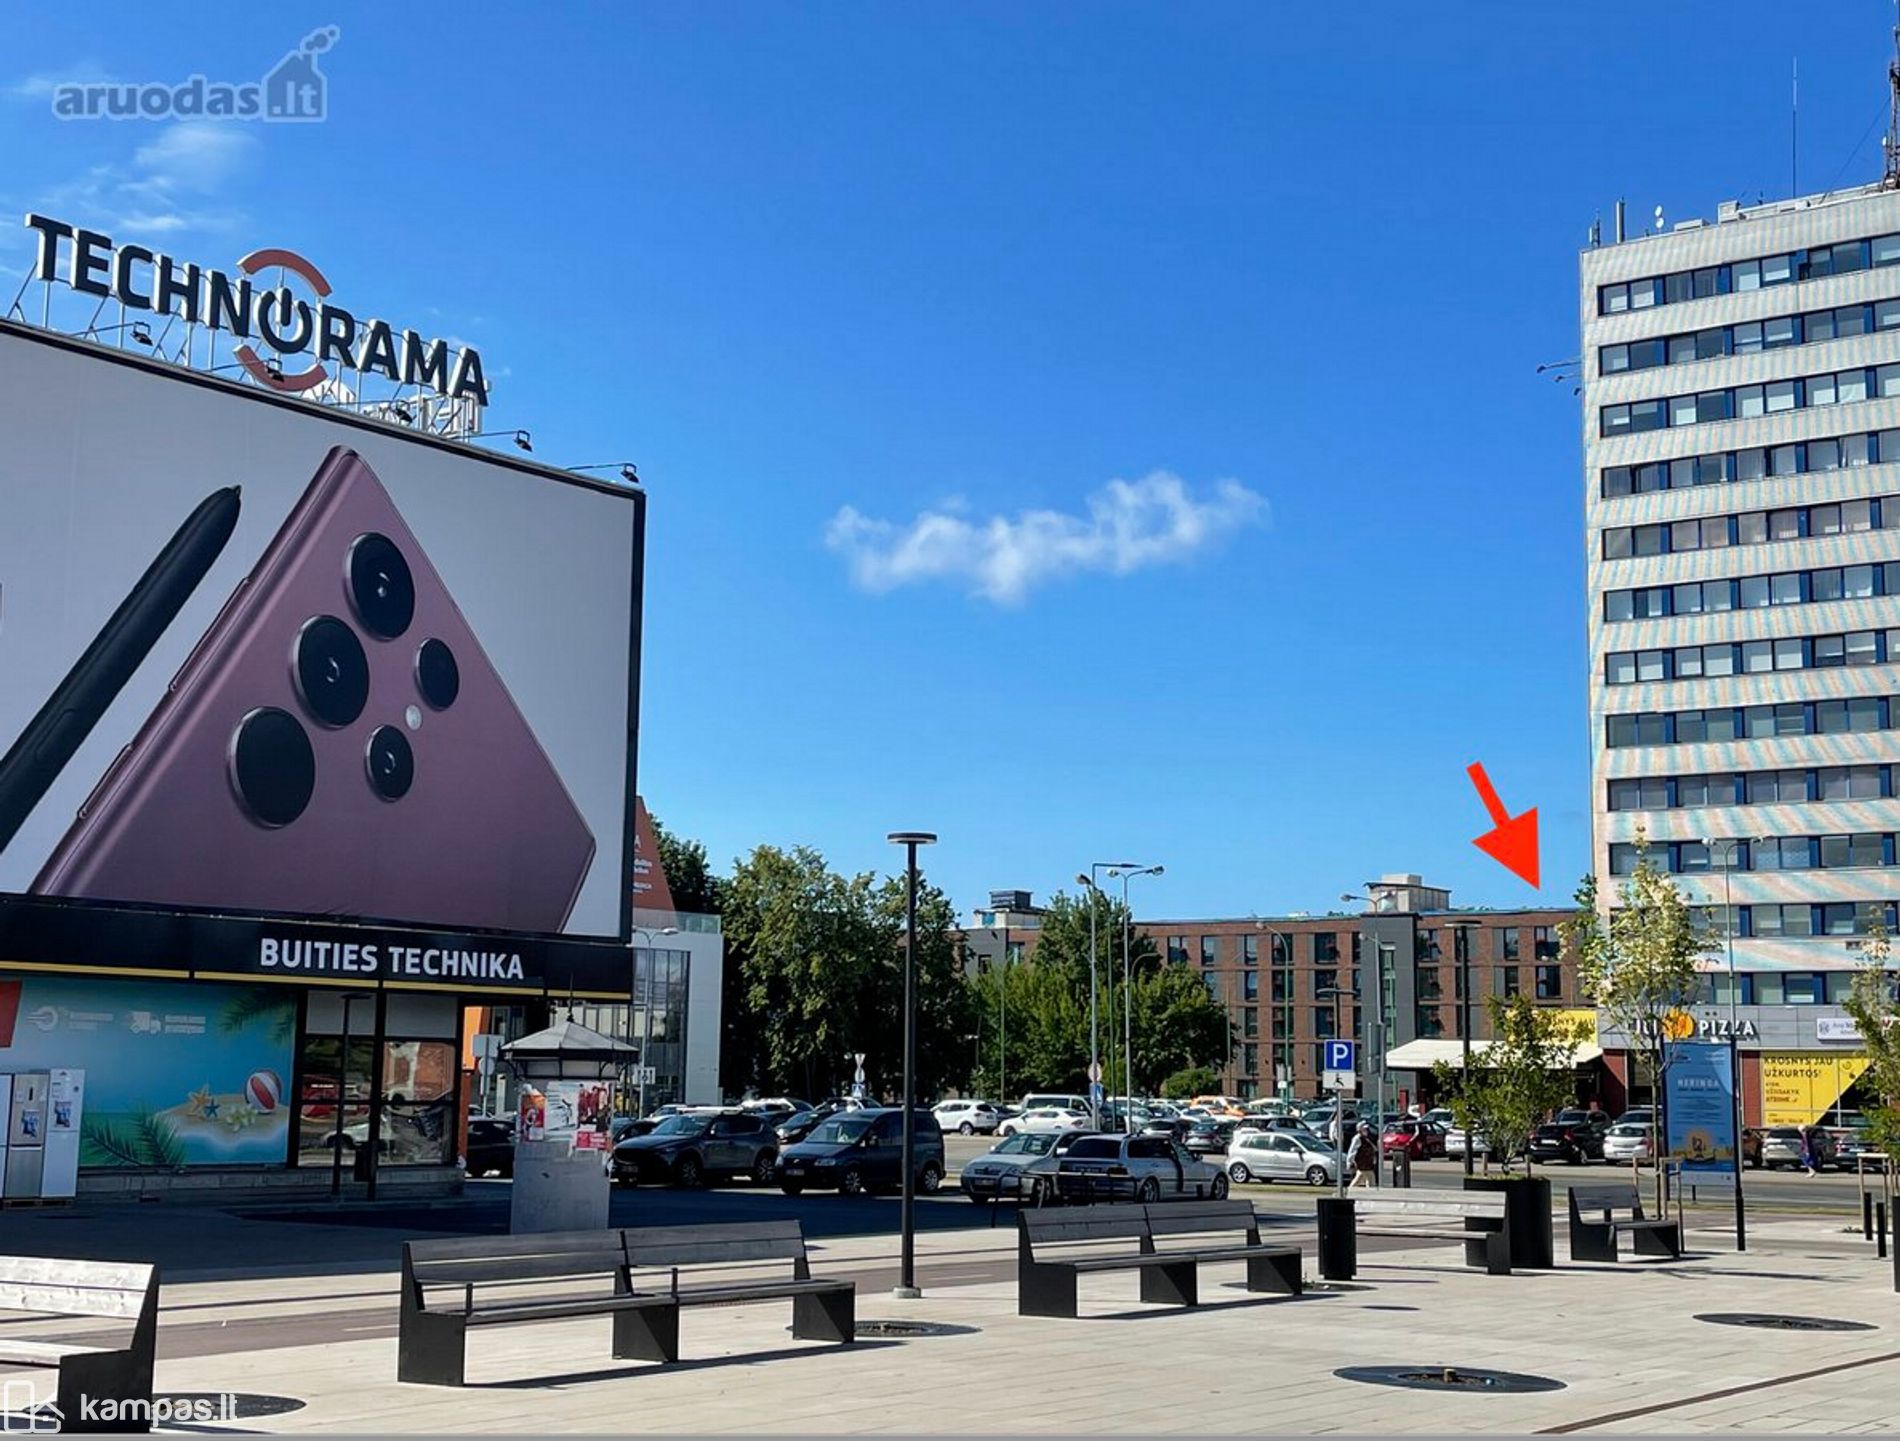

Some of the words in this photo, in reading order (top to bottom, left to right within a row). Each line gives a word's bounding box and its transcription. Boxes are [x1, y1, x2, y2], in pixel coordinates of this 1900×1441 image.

[24, 212, 489, 407] TECHNORAMA
[260, 938, 378, 972] BUITIES
[388, 946, 525, 980] TECHNIKA
[1700, 1019, 1754, 1037] PIZZA
[1333, 1043, 1349, 1068] P
